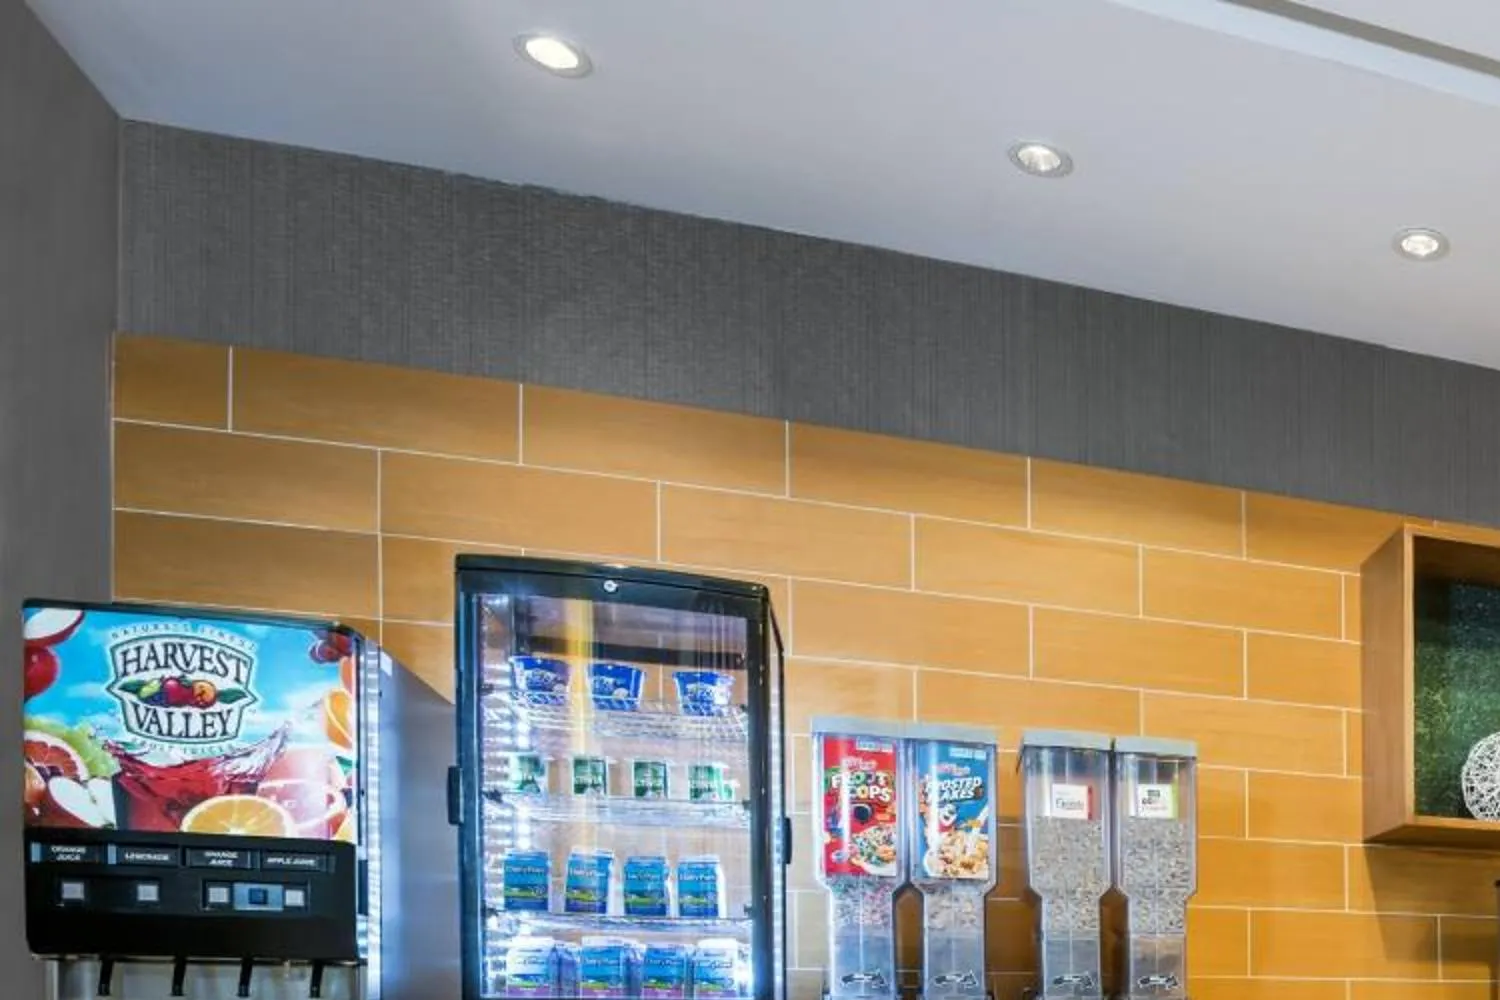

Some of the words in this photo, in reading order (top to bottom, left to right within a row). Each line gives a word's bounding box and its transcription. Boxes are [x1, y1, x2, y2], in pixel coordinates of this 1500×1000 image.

[120, 641, 248, 683] HARVEST
[131, 701, 233, 738] VALLEY
[831, 771, 889, 789] FOOT
[842, 784, 891, 803] OOPS
